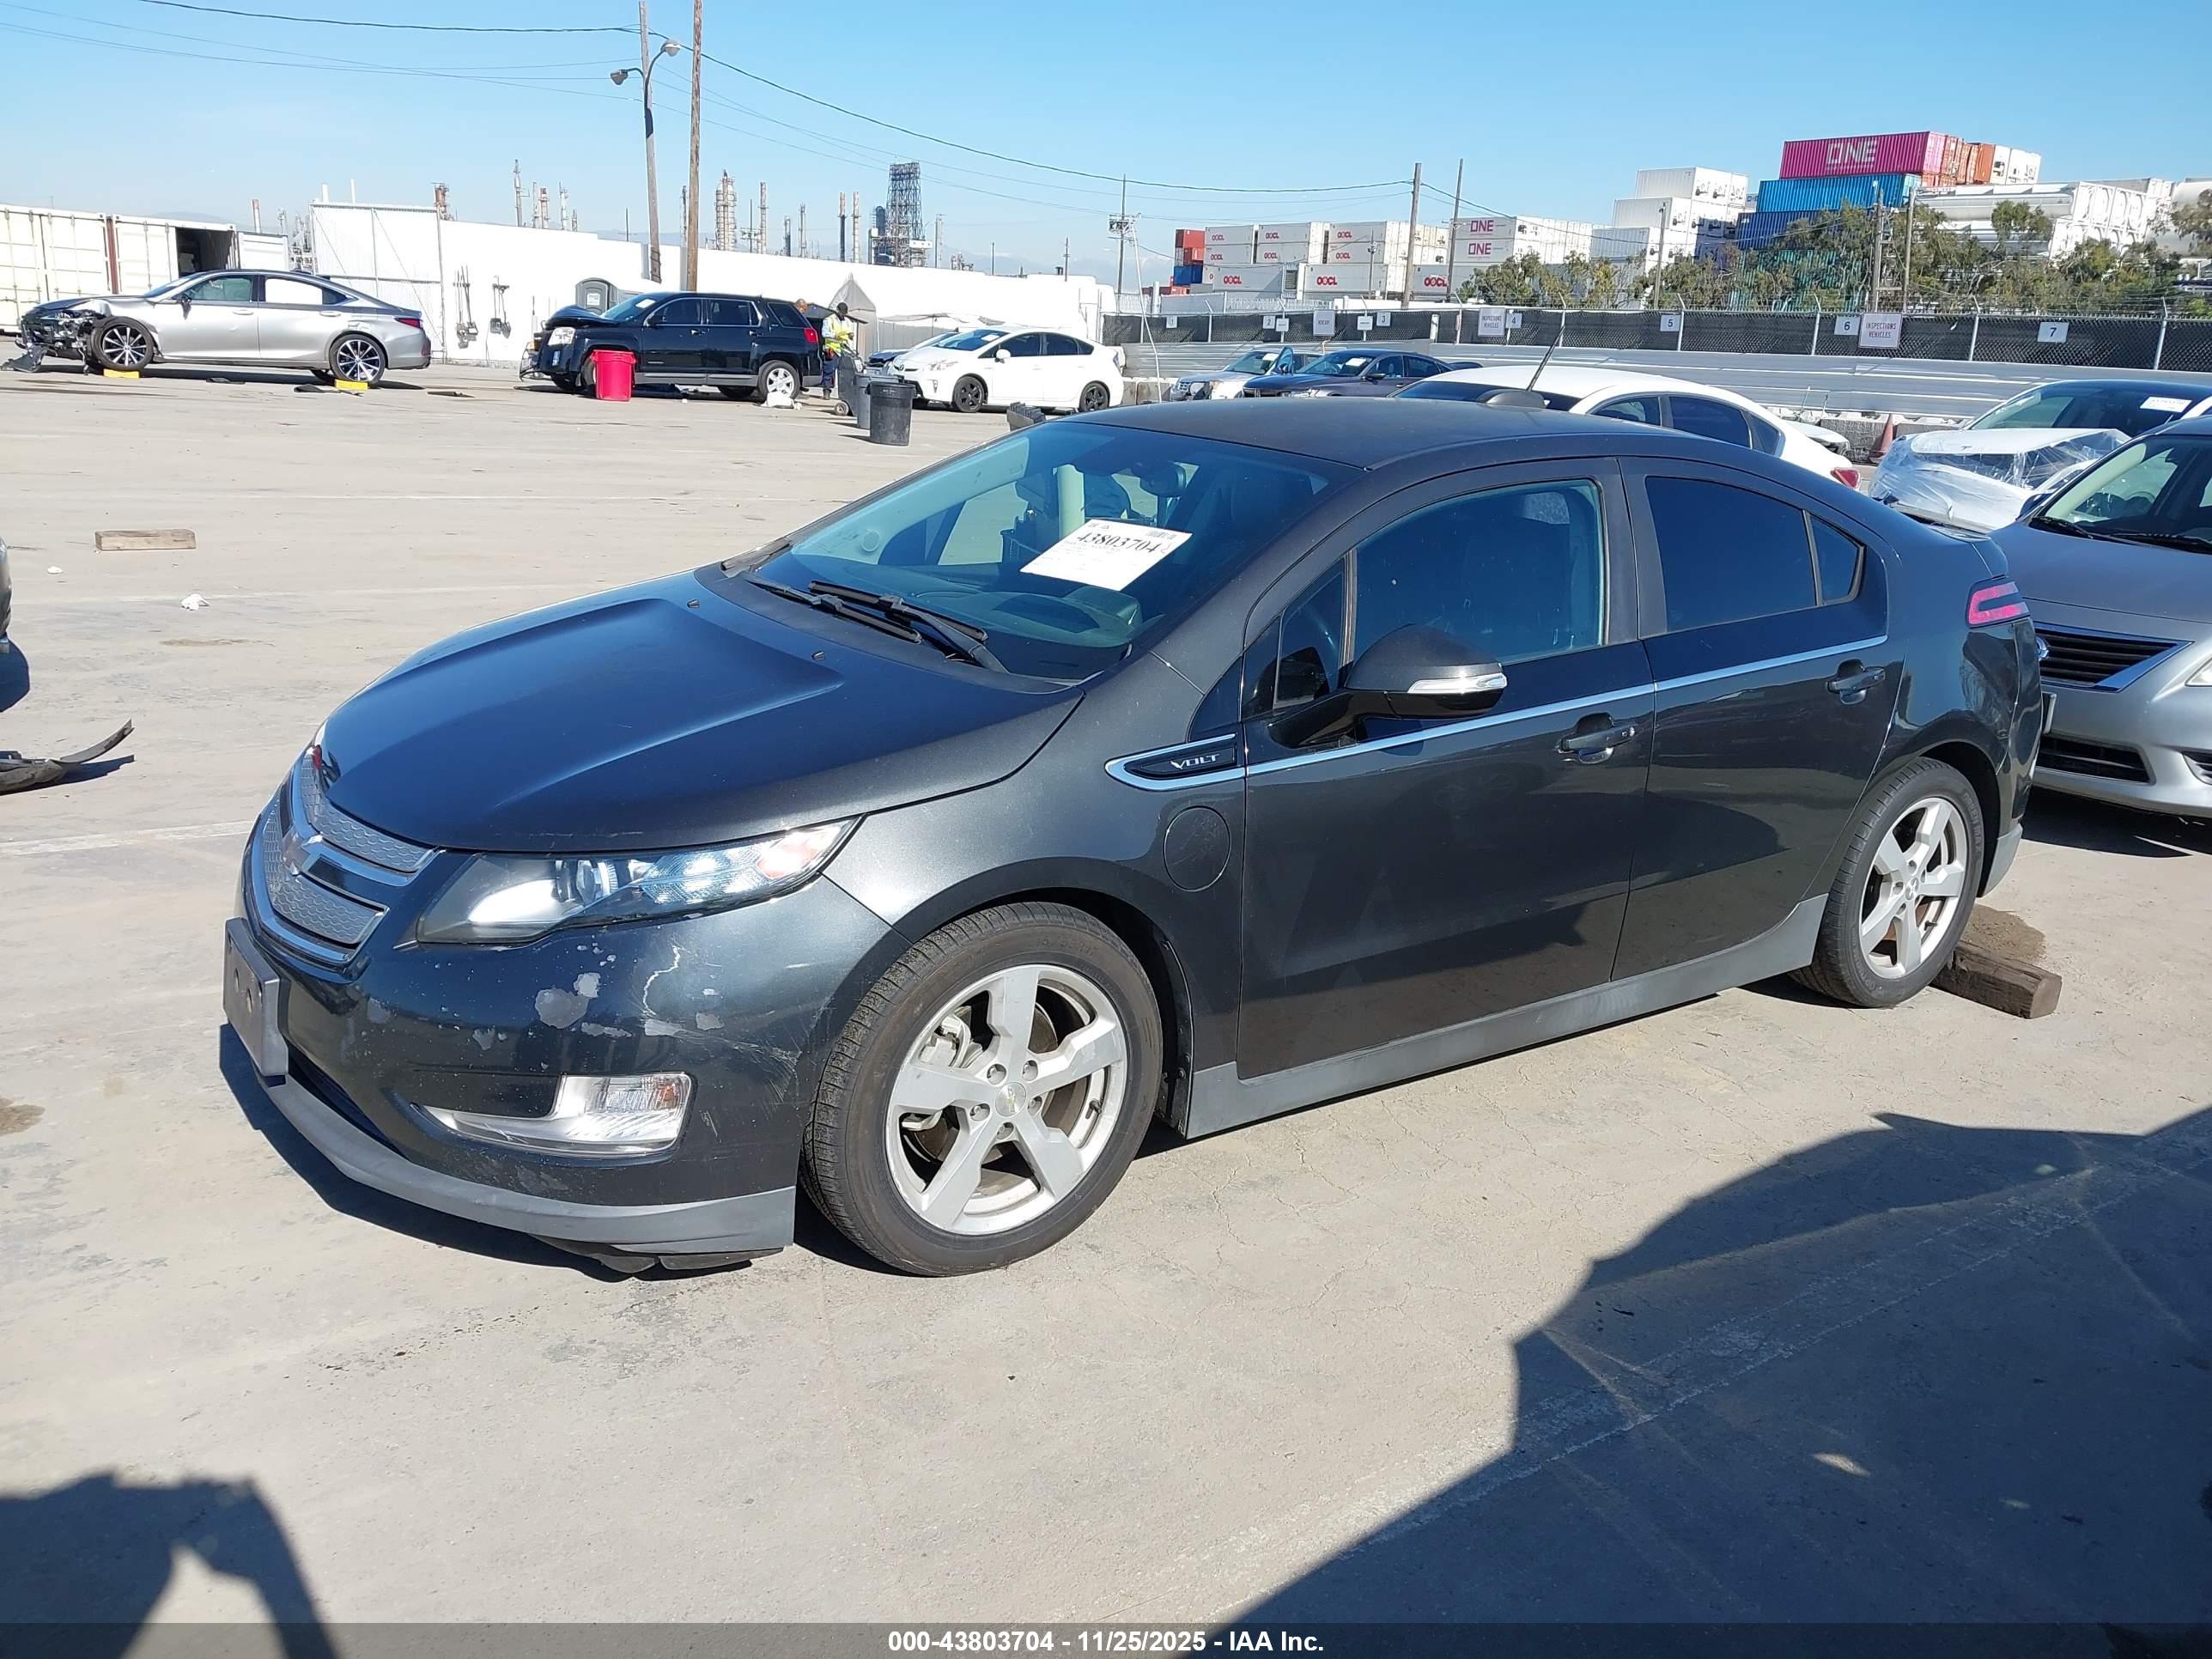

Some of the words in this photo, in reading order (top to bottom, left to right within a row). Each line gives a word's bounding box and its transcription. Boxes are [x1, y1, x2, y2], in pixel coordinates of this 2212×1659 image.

[1826, 140, 1878, 165] ONE
[1469, 220, 1494, 233] ONE
[1468, 242, 1492, 255] ONE
[1223, 275, 1243, 285] OOCL
[1316, 276, 1338, 286] OOCL
[1424, 276, 1449, 287] OOCL
[1511, 316, 1516, 325] 4
[1668, 319, 1674, 327] 5
[1844, 321, 1851, 331] 6
[2050, 327, 2057, 337] 7
[1077, 532, 1163, 553] 43803704
[1170, 753, 1220, 770] VOLT
